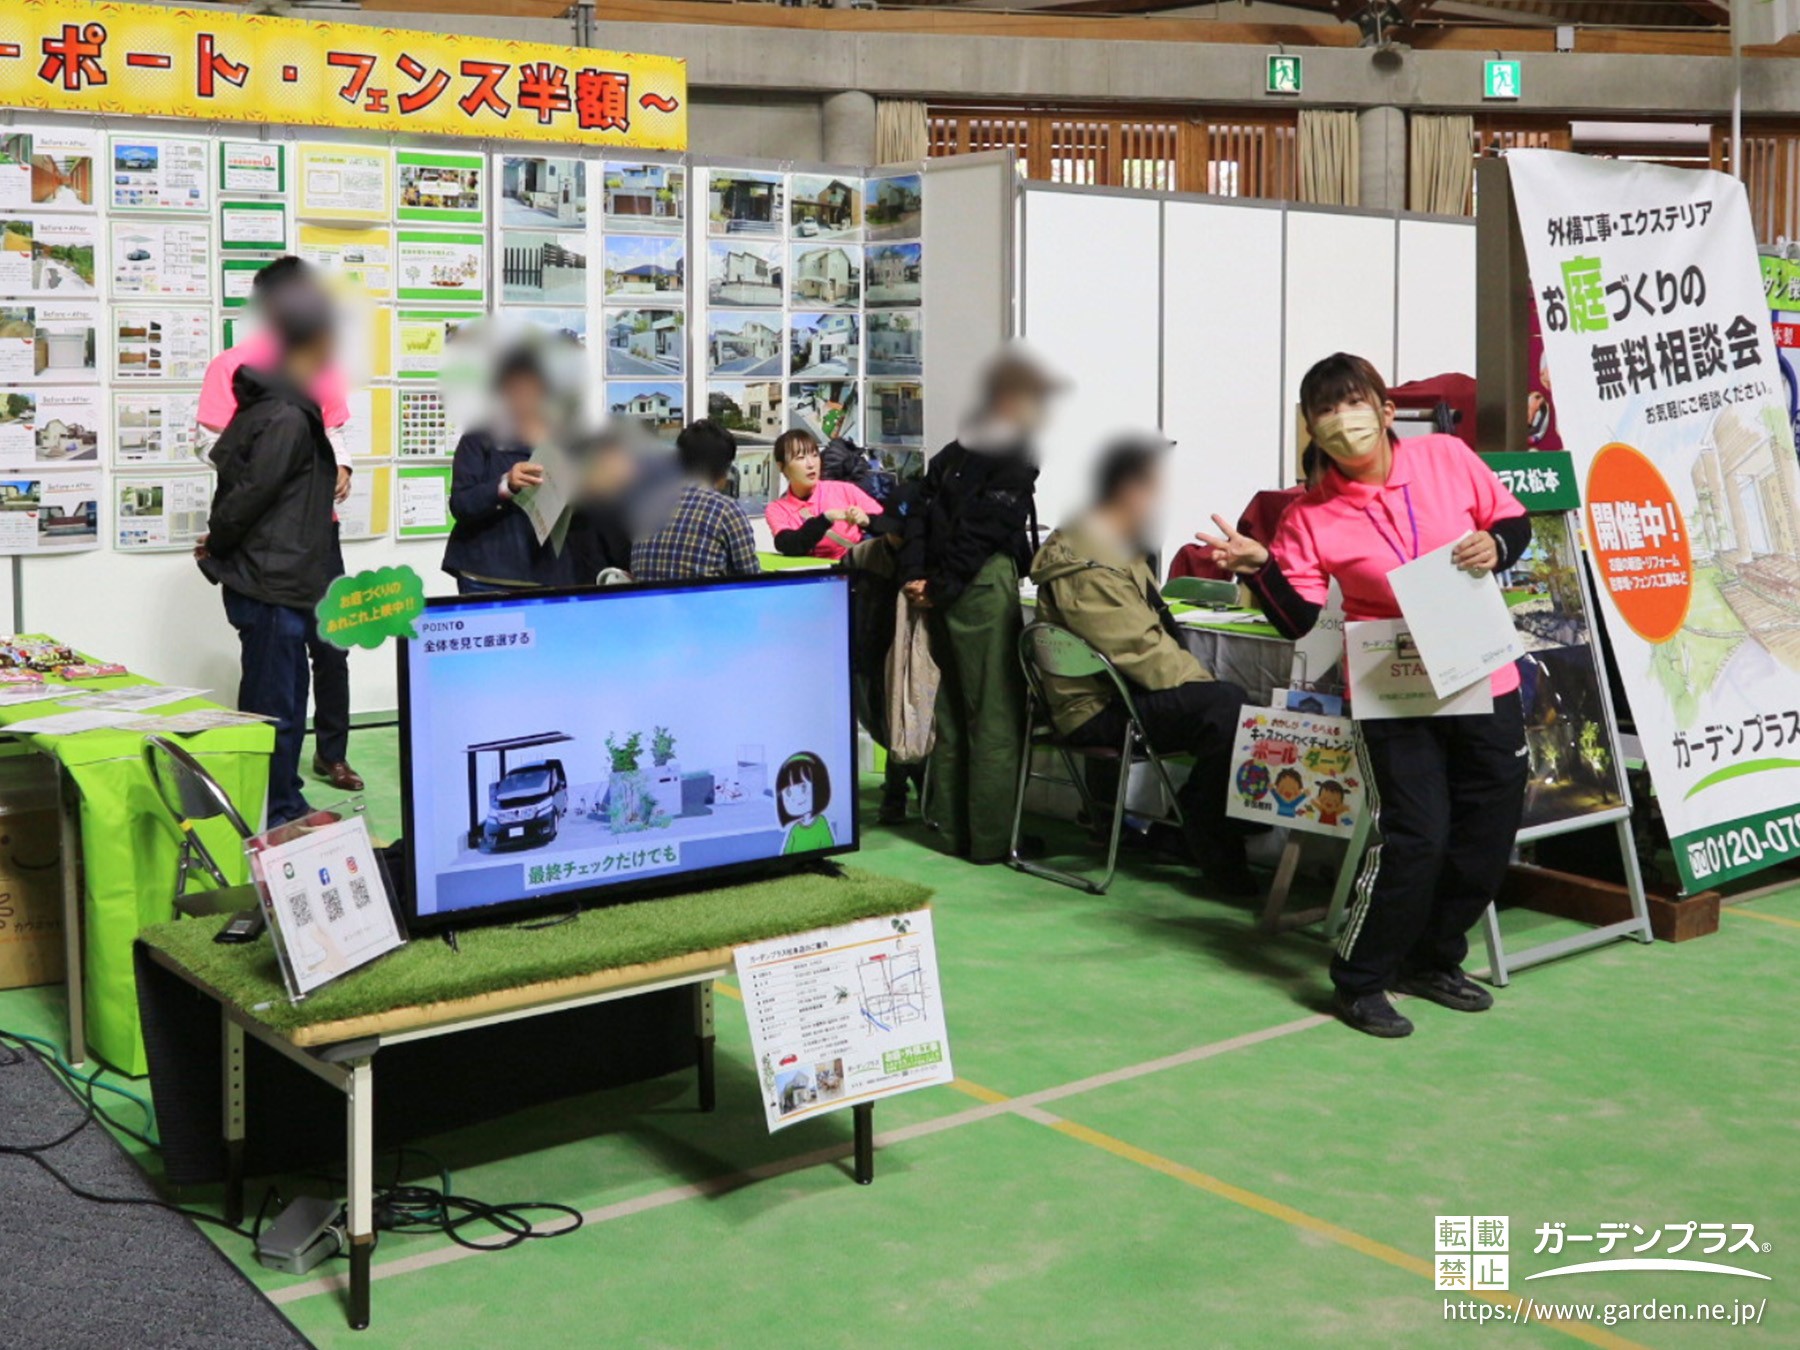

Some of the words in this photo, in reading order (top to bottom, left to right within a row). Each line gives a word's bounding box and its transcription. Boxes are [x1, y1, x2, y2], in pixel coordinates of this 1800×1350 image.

[1547, 201, 1713, 246] 外構工事・エクステリア
[1541, 255, 1706, 335] お庭づくりの
[1590, 315, 1762, 401] 無料相談会
[1645, 380, 1773, 424] お気軽にご相談ください。
[1493, 467, 1560, 494] ラス松本
[1590, 499, 1681, 552] 開催中!
[341, 582, 401, 609] お庭づくりの
[424, 632, 530, 653] 全体を見て厳選する
[1391, 662, 1428, 677] STA
[1673, 711, 1800, 768] ガーデンプラス
[528, 844, 678, 885] 最終チェックだけでも
